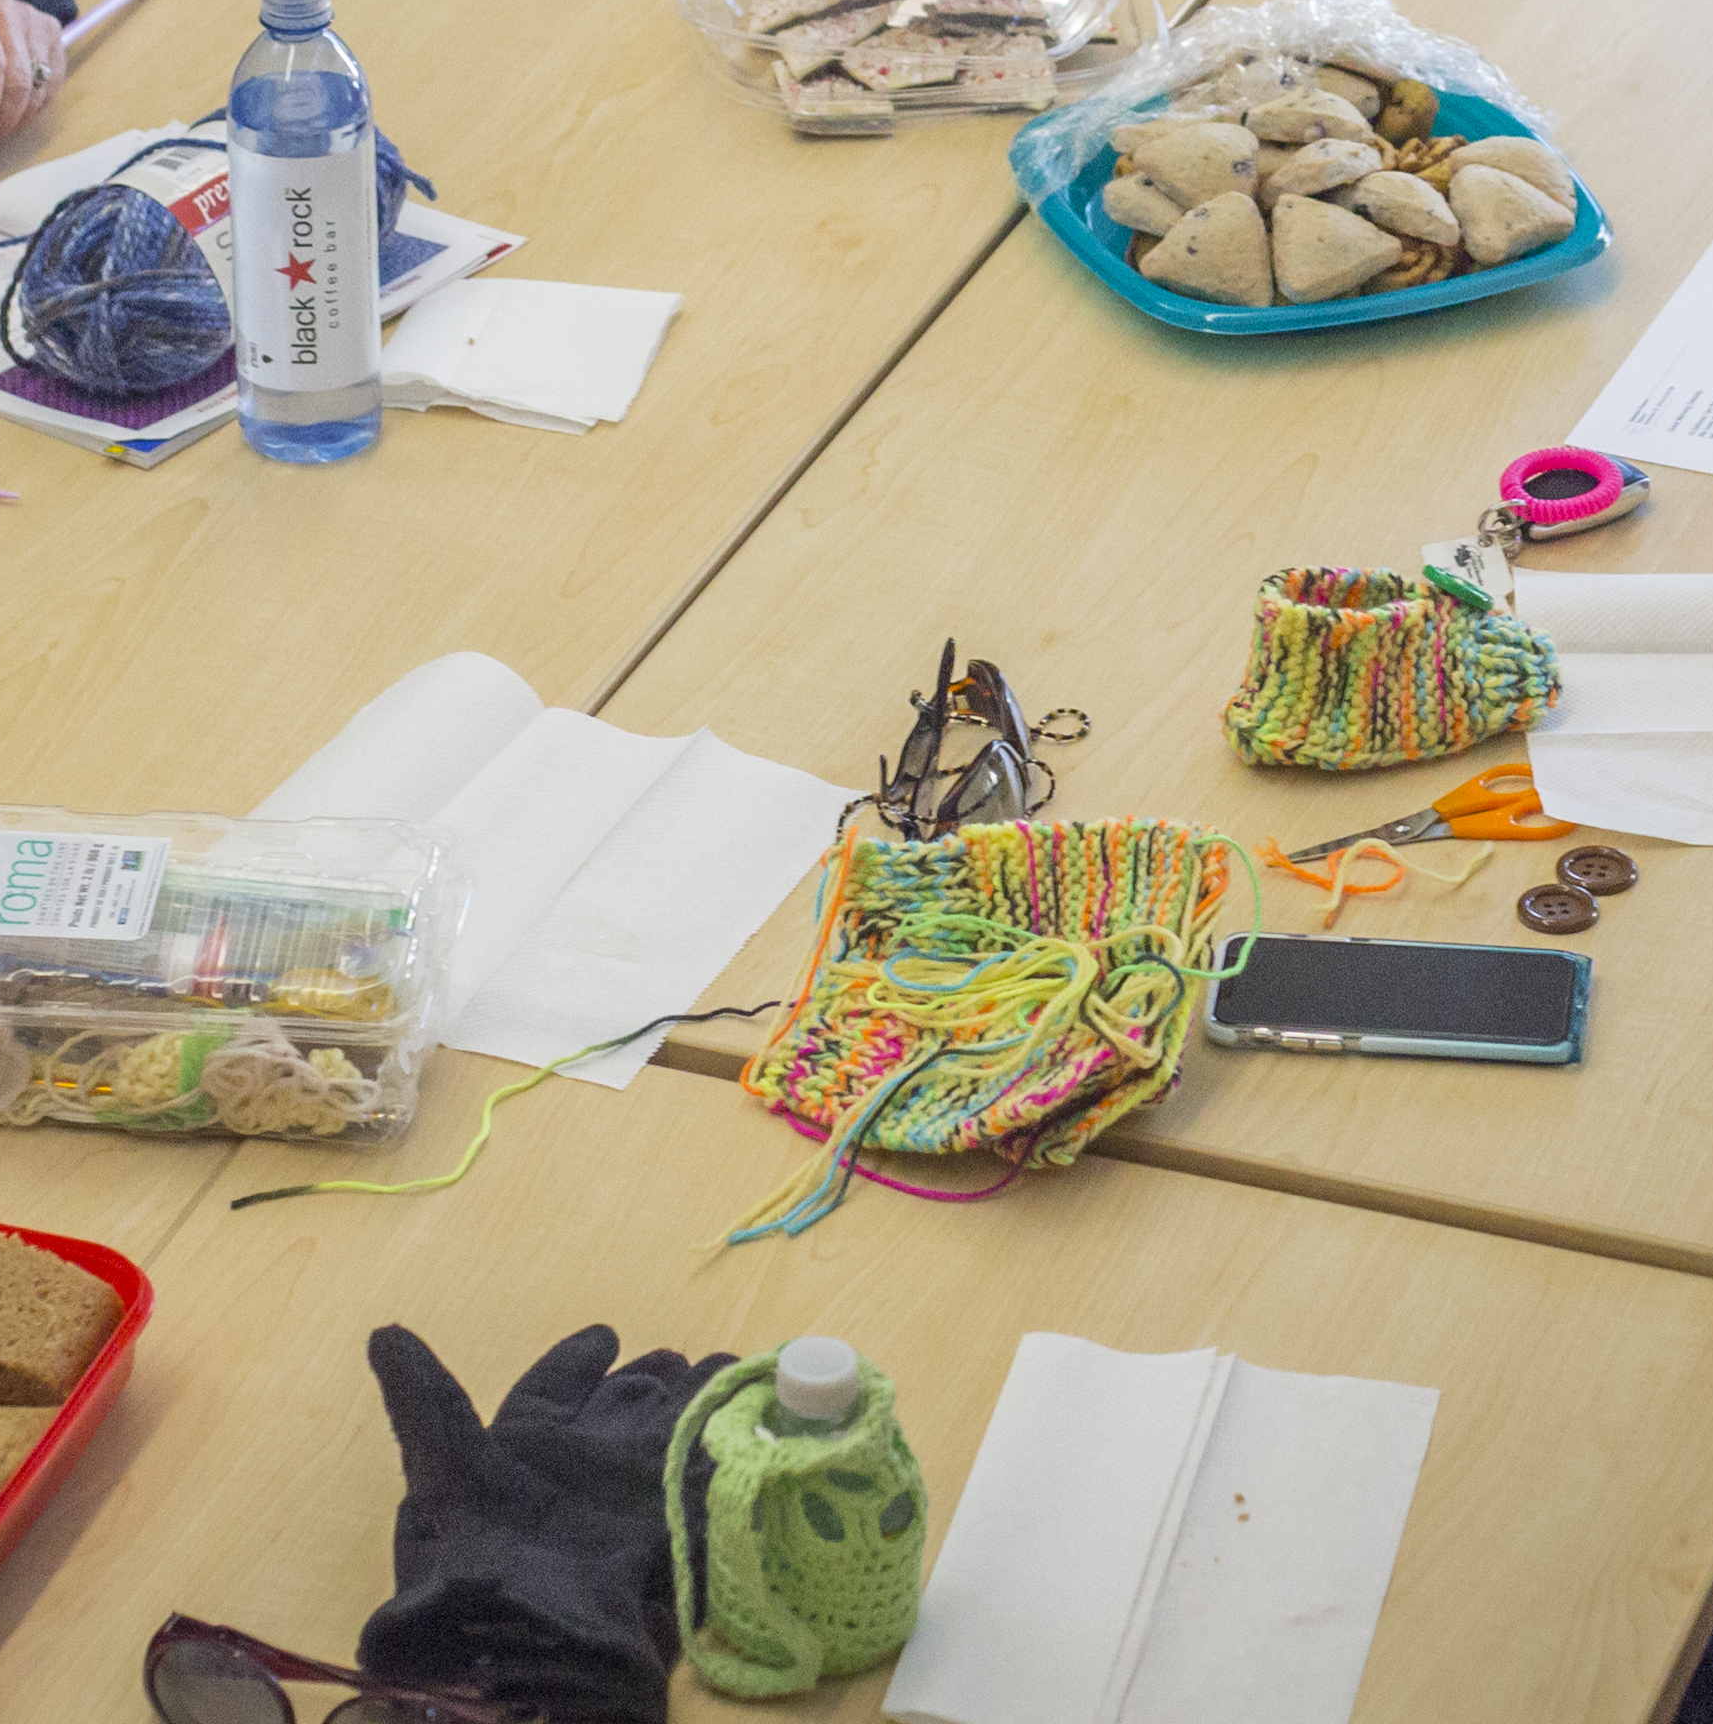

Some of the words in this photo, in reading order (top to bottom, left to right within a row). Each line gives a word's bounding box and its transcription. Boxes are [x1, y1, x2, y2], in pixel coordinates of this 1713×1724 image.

[286, 187, 313, 248] rock
[324, 220, 337, 253] bar
[324, 262, 338, 329] coffee
[289, 296, 318, 365] black
